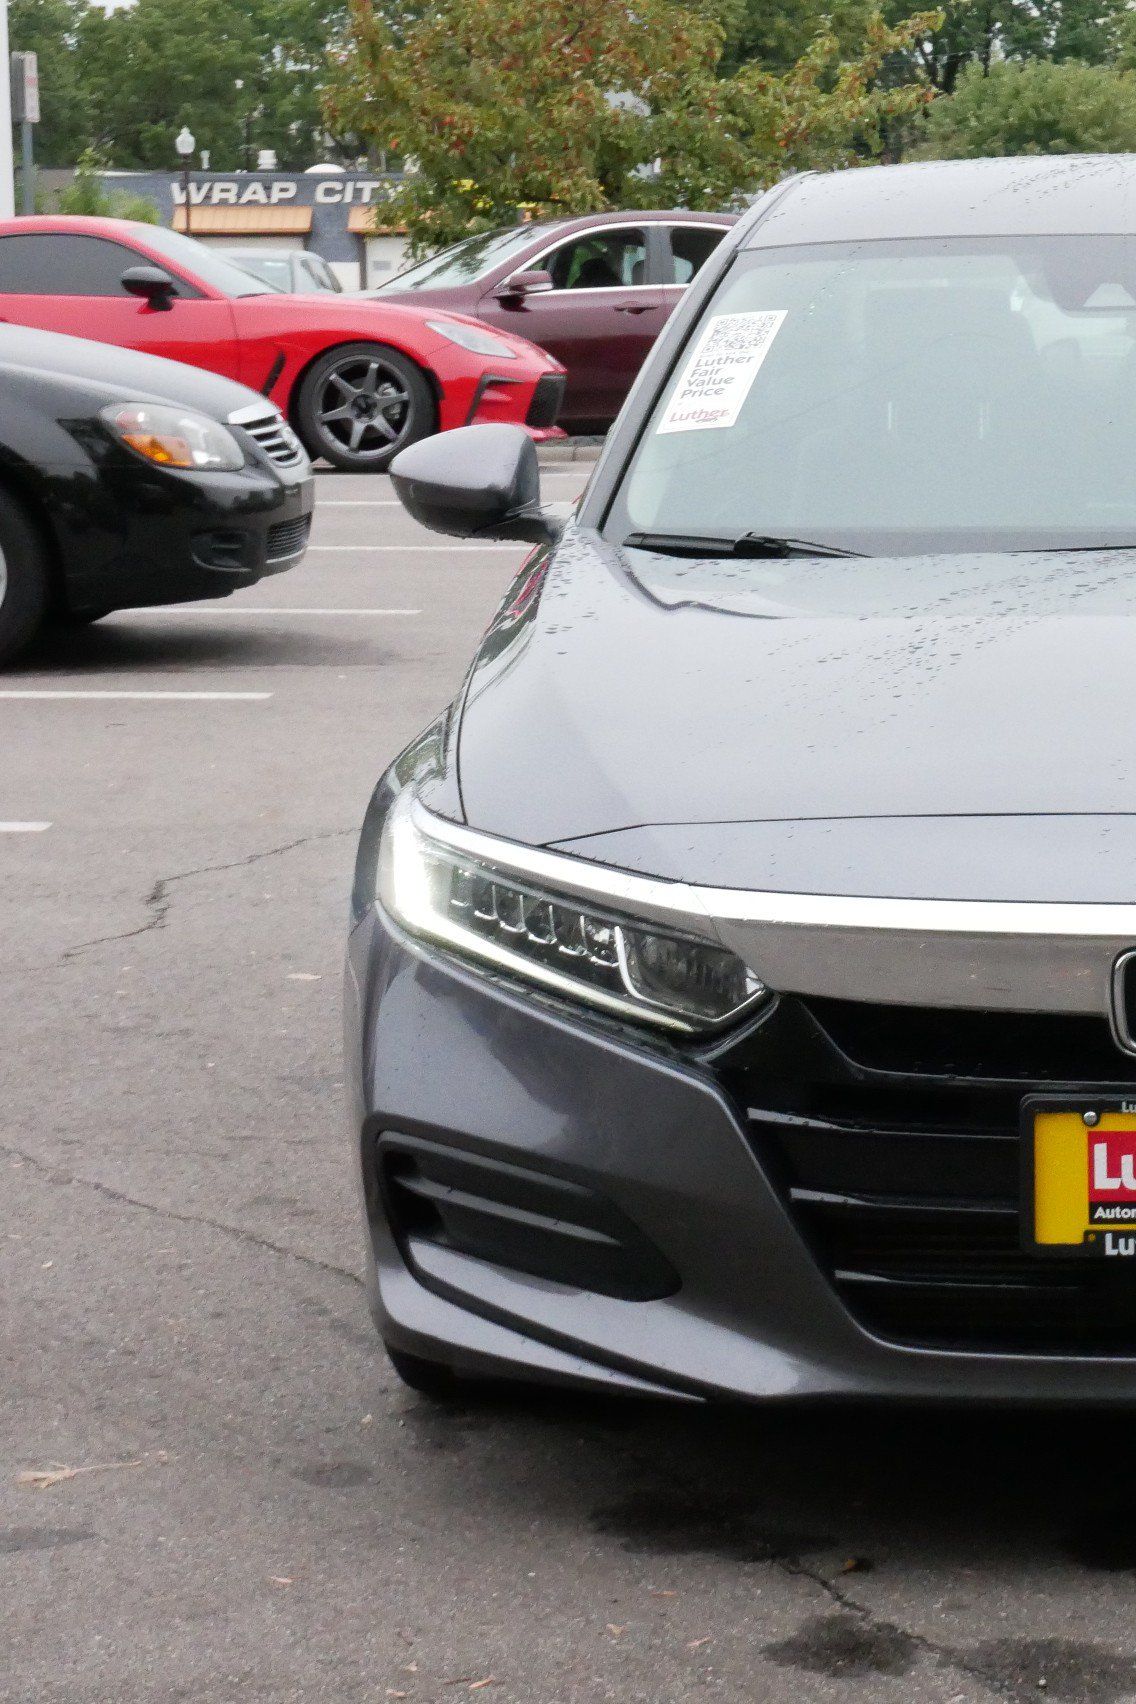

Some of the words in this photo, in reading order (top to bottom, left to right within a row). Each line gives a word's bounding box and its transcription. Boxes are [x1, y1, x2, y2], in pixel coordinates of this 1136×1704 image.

[170, 181, 297, 204] WRAP
[695, 355, 755, 368] Luther
[690, 366, 723, 378] Fair
[687, 376, 735, 388] Value
[680, 387, 726, 399] Price
[669, 408, 730, 422] Luther
